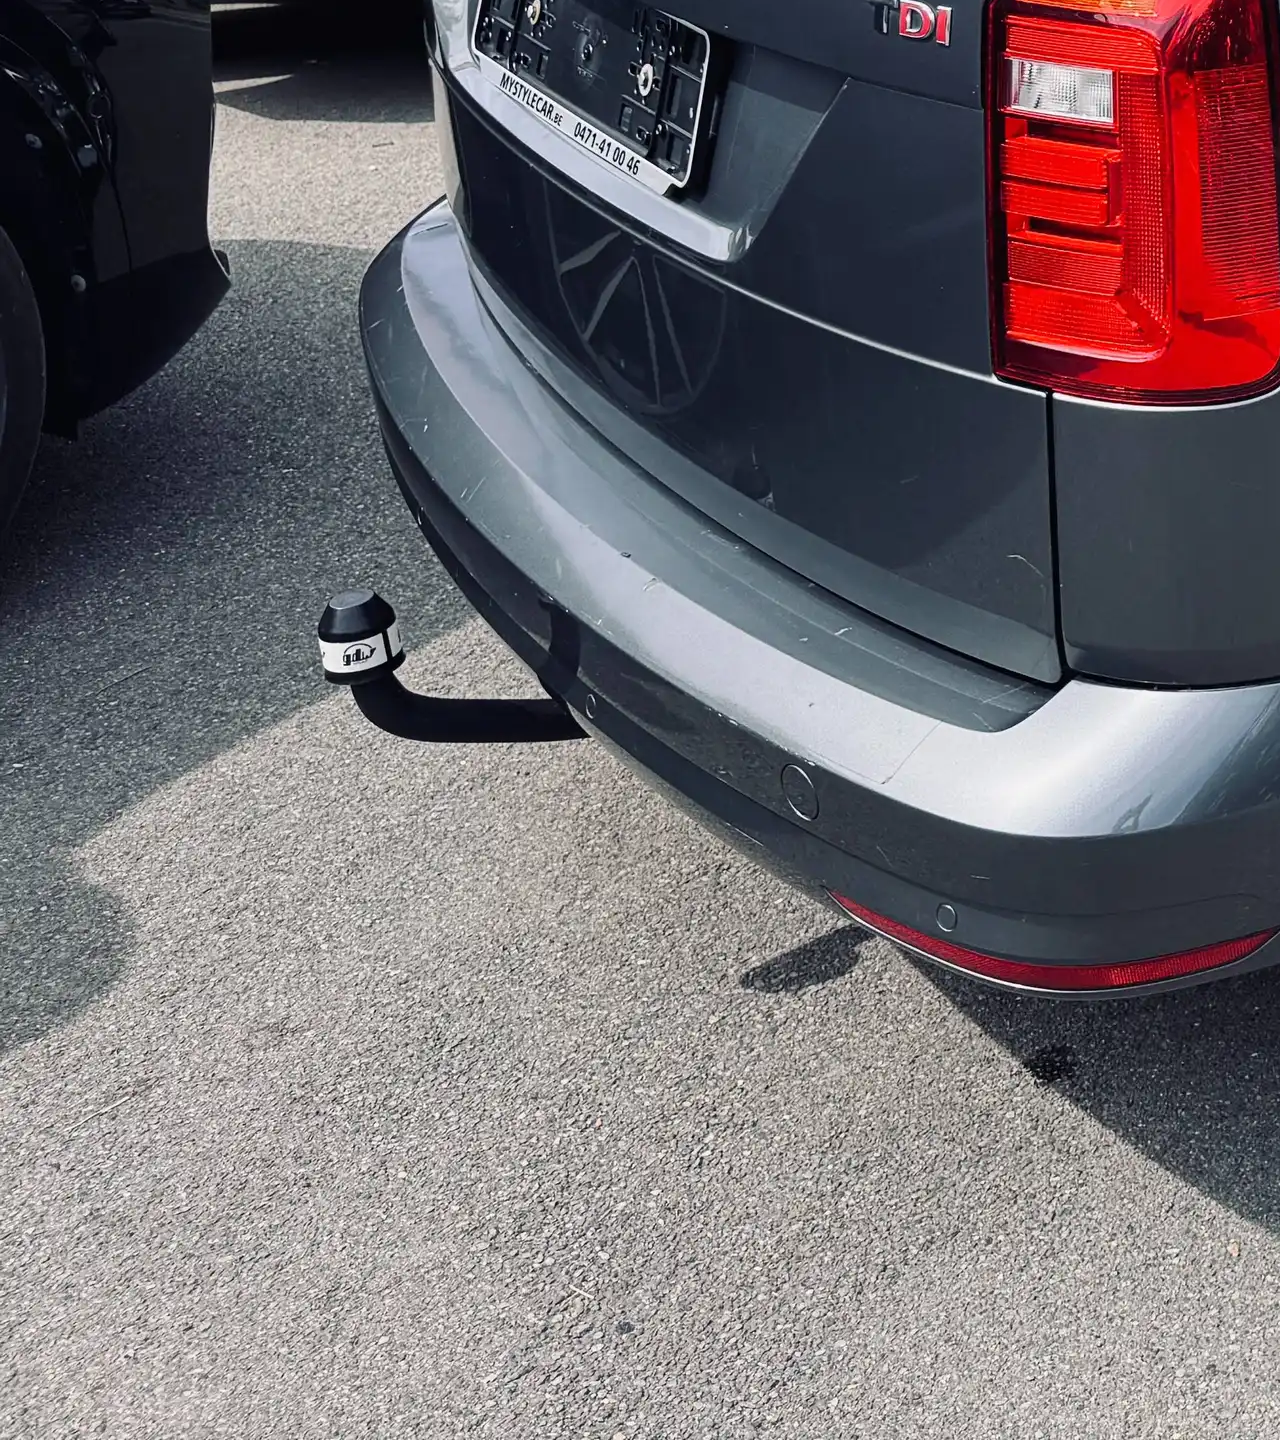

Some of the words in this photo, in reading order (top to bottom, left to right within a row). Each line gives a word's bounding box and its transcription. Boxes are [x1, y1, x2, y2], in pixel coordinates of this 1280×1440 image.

[573, 121, 613, 158] 0471-41
[612, 146, 627, 166] 00
[626, 155, 641, 176] 46
